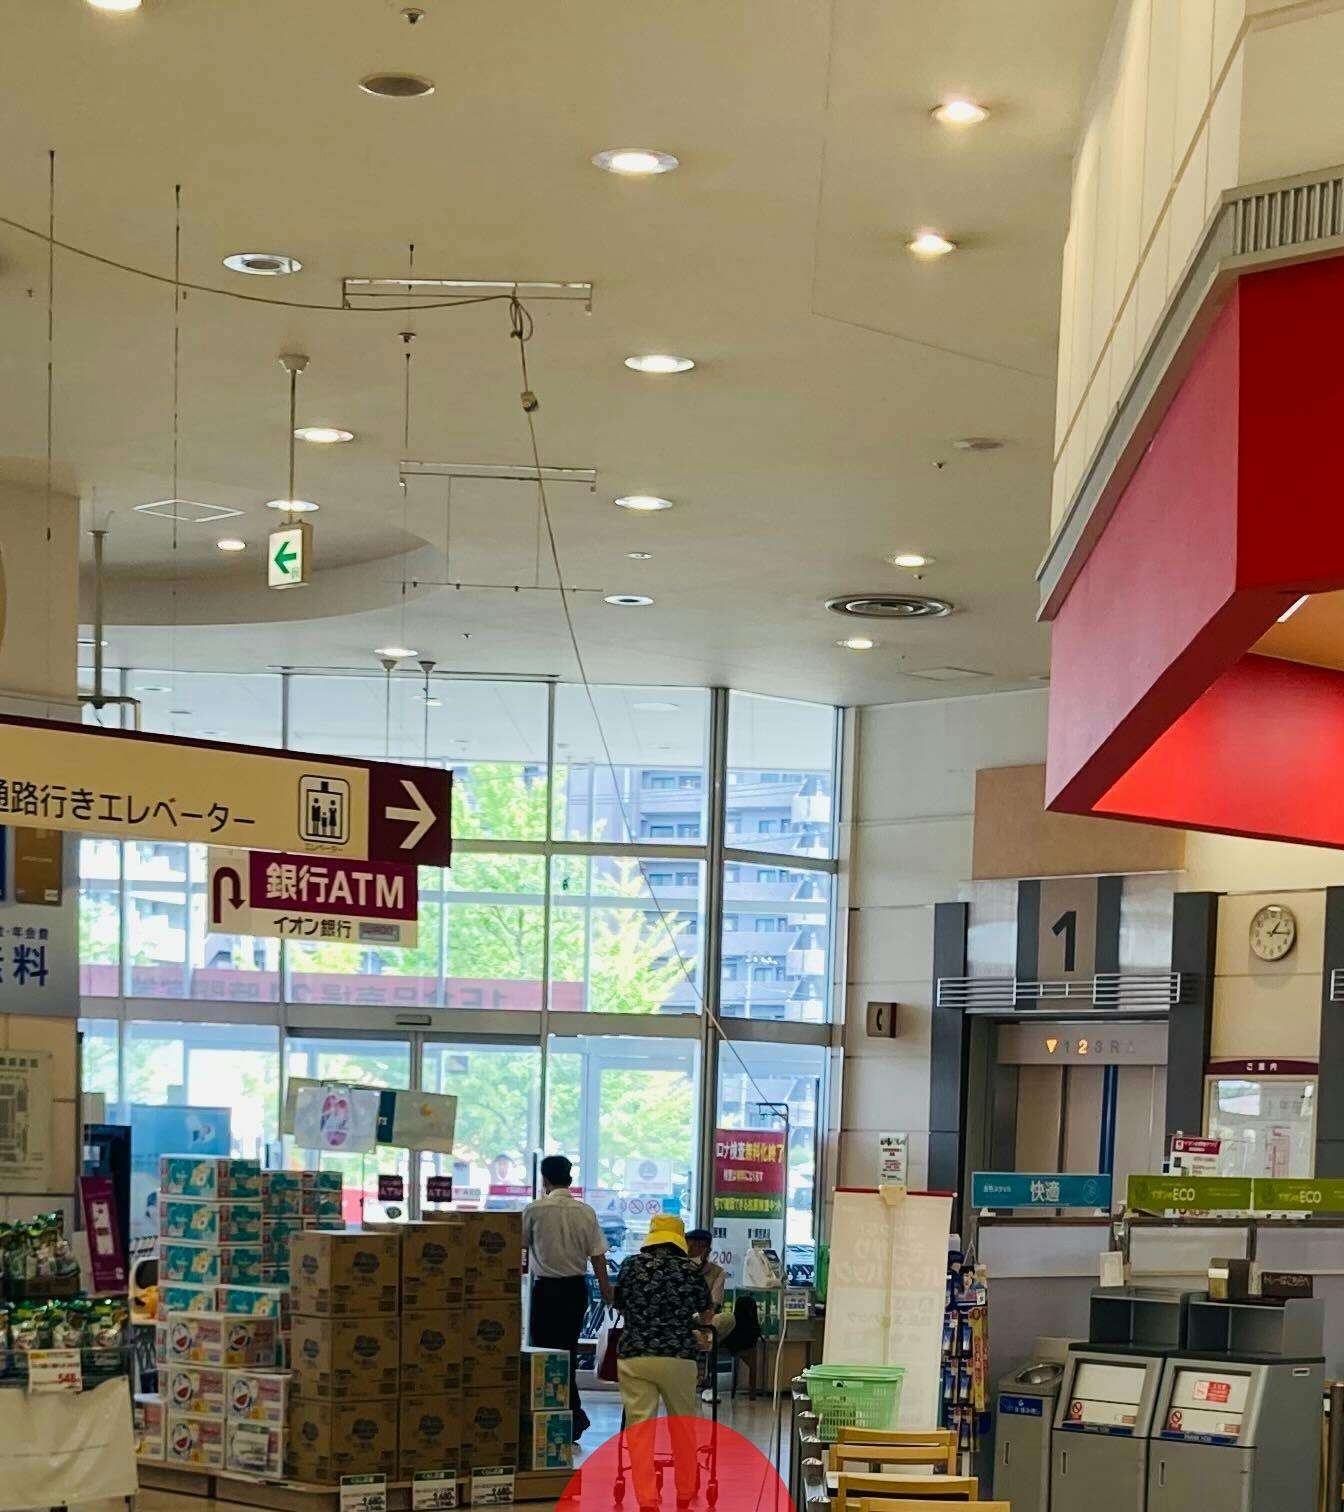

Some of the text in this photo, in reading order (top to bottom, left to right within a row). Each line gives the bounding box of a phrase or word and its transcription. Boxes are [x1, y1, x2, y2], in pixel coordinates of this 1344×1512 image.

[266, 862, 405, 910] 銀行ATM
[272, 915, 352, 939] イオン銀行
[1051, 910, 1077, 972] 1
[1078, 1039, 1088, 1054] 2
[1030, 1180, 1060, 1203] 快適
